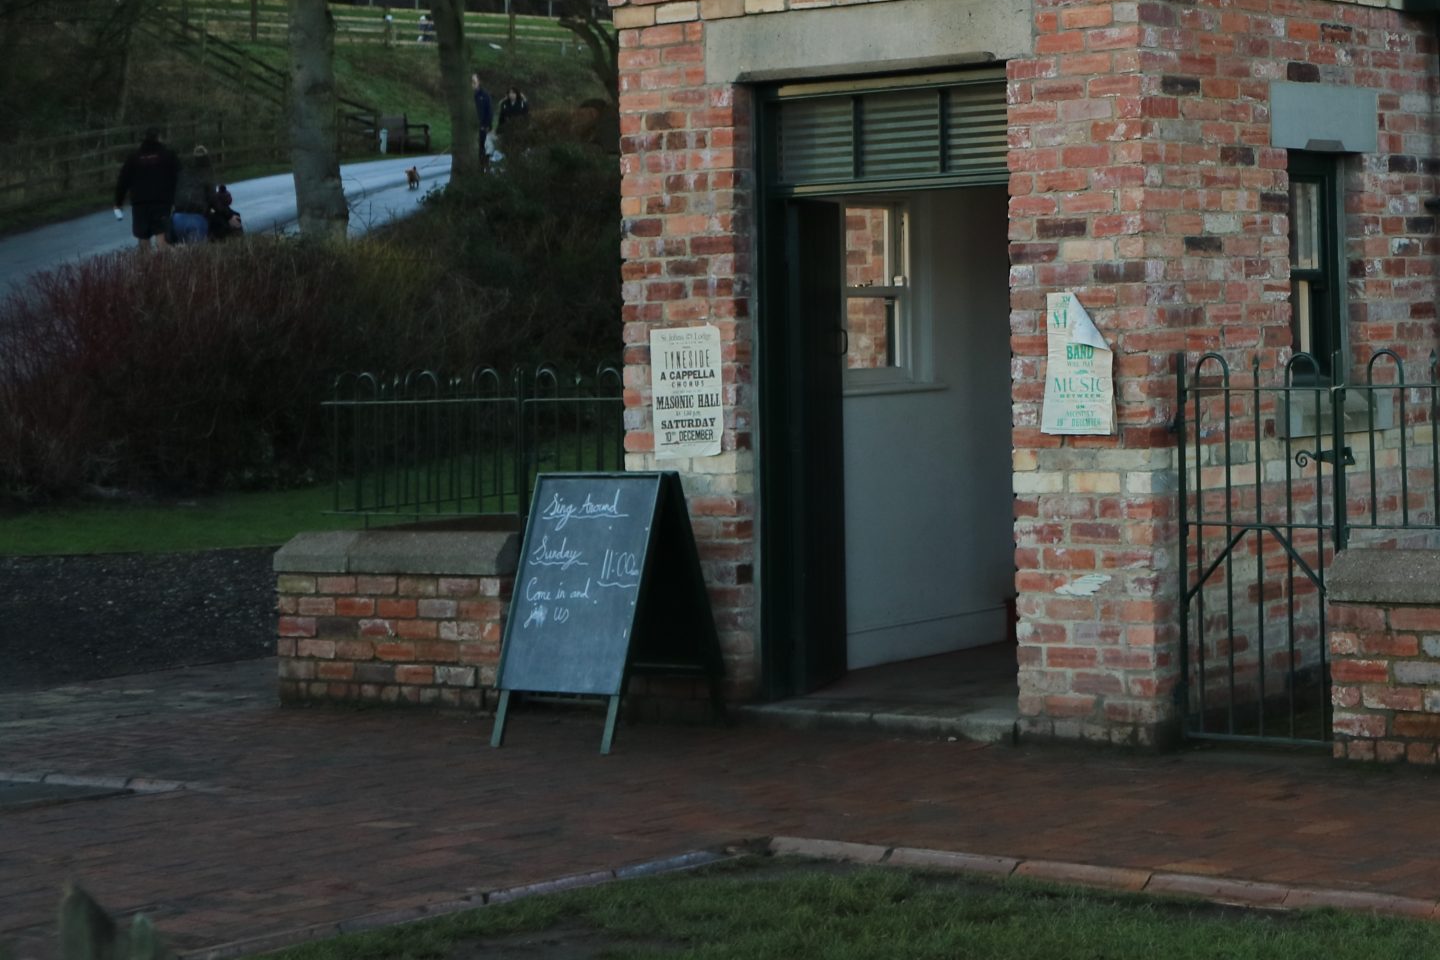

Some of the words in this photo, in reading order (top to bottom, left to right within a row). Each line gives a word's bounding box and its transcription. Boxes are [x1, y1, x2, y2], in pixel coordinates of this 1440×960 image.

[664, 349, 710, 369] TYNESIDE
[1066, 344, 1094, 360] BAND
[660, 371, 666, 381] A
[669, 369, 715, 380] CAPPELLA
[671, 380, 704, 388] CHORUS
[1053, 377, 1105, 393] MUSIC
[656, 395, 694, 410] MASONIC
[697, 393, 721, 408] HALL
[661, 417, 716, 430] SATURDAY
[1072, 418, 1101, 427] DECEMBER
[678, 429, 714, 442] DECEMBER
[543, 493, 576, 531] Sing
[579, 488, 620, 514] Around
[533, 535, 582, 571] Sunday
[526, 577, 552, 601] Come
[555, 582, 565, 600] in
[569, 577, 590, 599] and
[553, 607, 569, 623] us
